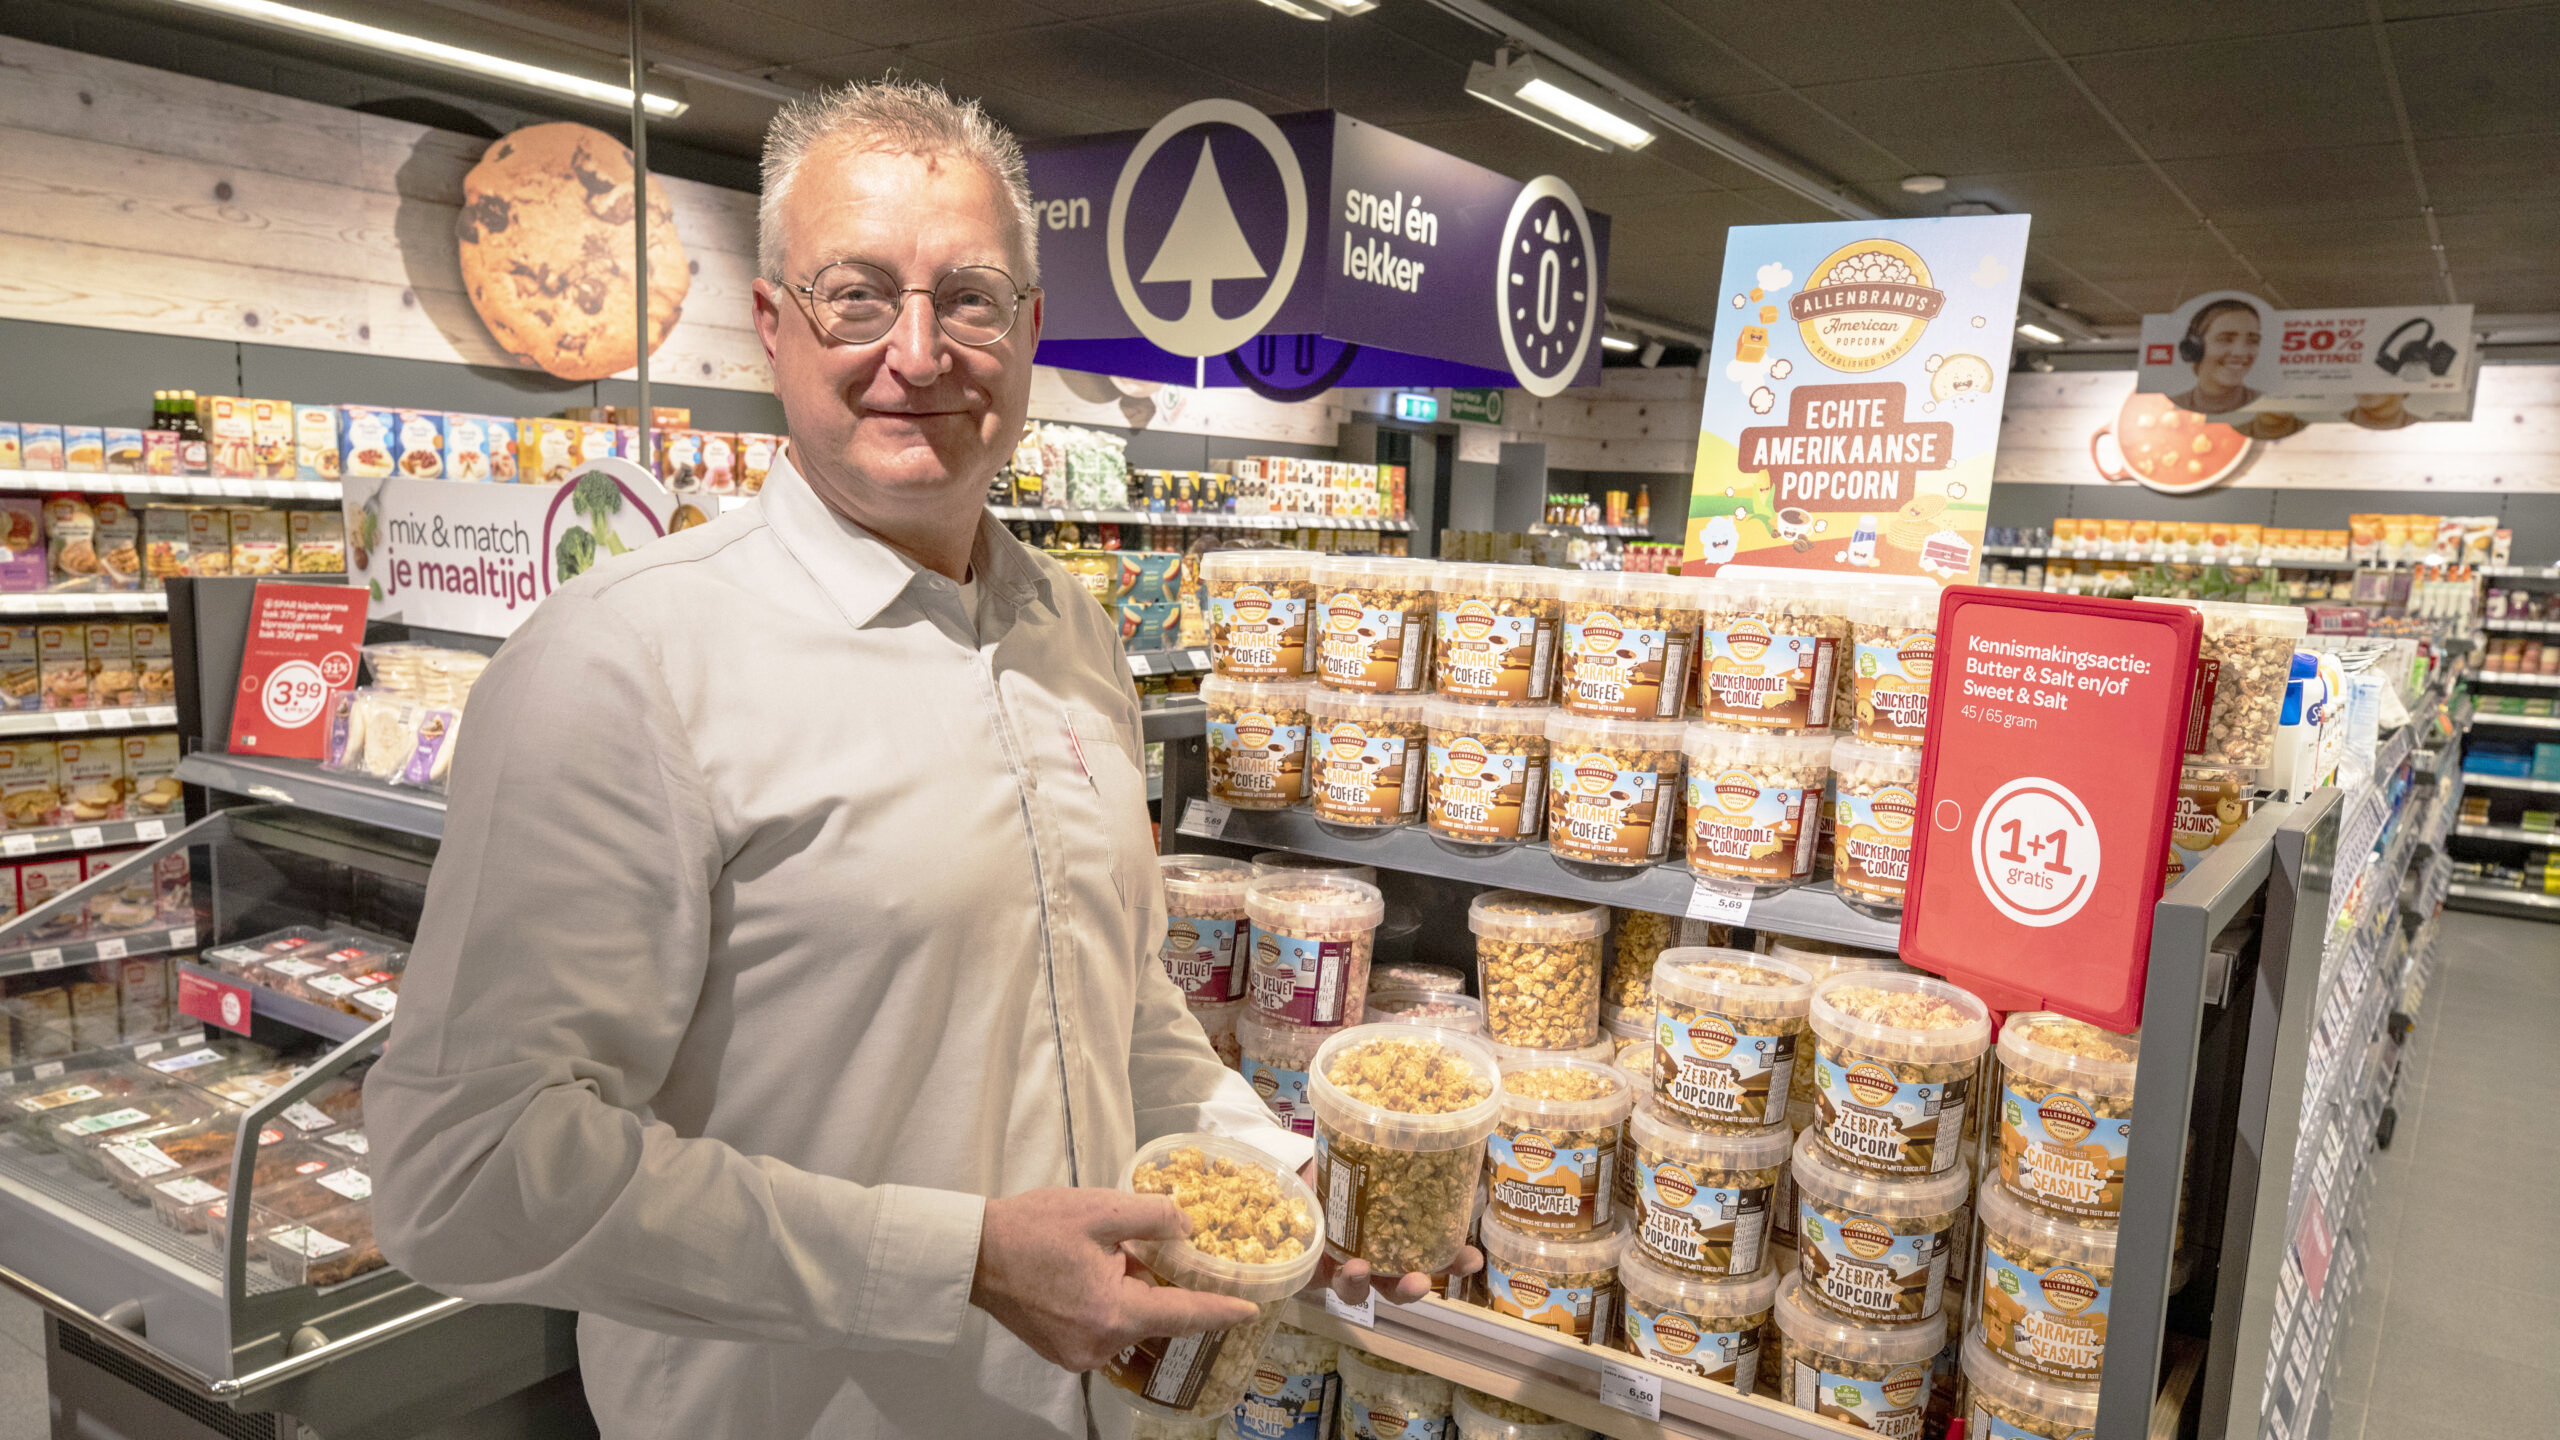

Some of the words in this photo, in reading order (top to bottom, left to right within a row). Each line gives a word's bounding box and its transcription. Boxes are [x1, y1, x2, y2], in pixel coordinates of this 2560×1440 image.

[1032, 197, 1090, 230] ren
[1345, 188, 1401, 236] snel
[1405, 195, 1438, 246] én
[1344, 231, 1424, 293] lekker
[1803, 290, 1929, 313] ALLENBRAND'S
[1823, 318, 1899, 335] American
[1836, 337, 1886, 346] POPCORN
[2282, 329, 2363, 352] 50%
[1817, 346, 1876, 368] ESTABLISHED
[2280, 353, 2362, 365] KORTING!
[1806, 398, 1886, 430] ECHTE
[1753, 433, 1938, 465] AMERIKAANSE
[1782, 470, 1899, 500] POPCORN
[389, 513, 428, 546] mix
[432, 516, 450, 548] &
[455, 520, 530, 555] match
[387, 548, 411, 595] je
[418, 557, 536, 609] maaltijd
[1231, 633, 1278, 648] CARAMEL
[1325, 640, 1367, 660] CARAMEL
[1236, 648, 1271, 664] COFFEE
[1452, 650, 1499, 669] CARAMEL
[1969, 634, 2150, 675] Kennismakingsactie:
[1328, 659, 1360, 676] COFFEE
[1455, 667, 1492, 685] COFFEE
[1578, 663, 1626, 684] CARAMEL
[1966, 657, 2021, 681] Butter
[2023, 666, 2037, 682] &
[2040, 668, 2074, 689] Salt
[2078, 674, 2128, 696] en/of
[1581, 682, 1618, 701] COFFEE
[1712, 673, 1785, 692] SNICKERDOODLE
[273, 681, 322, 706] 3.99
[1726, 690, 1761, 706] COOKIE
[1876, 692, 1928, 710] SNICKERD
[1963, 679, 2013, 704] Sweet
[2017, 688, 2030, 704] &
[2033, 690, 2068, 711] Salt
[1896, 710, 1926, 725] COOK
[1961, 705, 1977, 720] 45
[1986, 708, 2002, 723] 65
[2004, 713, 2037, 730] gram
[1230, 757, 1277, 774] CARAMEL
[1235, 773, 1271, 789] COFFEE
[1326, 767, 1372, 787] CARAMEL
[1330, 786, 1364, 803] COFFEE
[1443, 785, 1491, 806] CARAMEL
[1204, 816, 1222, 826] 5,69
[1446, 803, 1482, 822] COFFEE
[1567, 802, 1620, 825] CARAMEL
[1571, 821, 1611, 842] COFFEE
[1698, 821, 1772, 843] SNICKERDOODLE
[2173, 815, 2214, 833] SNICKE
[1712, 839, 1750, 857] COOKIE
[1850, 840, 1910, 863] SNICKERDOO
[2000, 818, 2073, 877] 1+1
[1868, 859, 1907, 878] COOKIE
[2008, 865, 2054, 890] gratis
[1718, 899, 1742, 909] 5,69
[1177, 961, 1213, 977] VELVET
[1263, 976, 1295, 996] VELVET
[1256, 989, 1275, 1007] CAKE
[1682, 1064, 1727, 1090] ZEBRA
[1849, 1075, 1894, 1092] ALLENBRAND'S
[1675, 1082, 1735, 1110] POPCORN
[1841, 1110, 1889, 1138] ZEBRA
[2042, 1110, 2091, 1127] ALLENBRAND'S
[1834, 1127, 1898, 1159] POPCORN
[2027, 1148, 2092, 1181] CARAMEL
[2069, 1150, 2088, 1159] FINEST
[2033, 1172, 2096, 1201] SEASALT
[1497, 1183, 1576, 1212] STROOPWAFEL
[1650, 1209, 1689, 1238] ZEBRA
[1645, 1226, 1697, 1258] POPCORN
[1844, 1230, 1890, 1245] ALLENBRAND'S
[1835, 1262, 1884, 1289] ZEBRA
[1827, 1278, 1893, 1309] POPCORN
[2045, 1282, 2093, 1297] ALLENBRAND'S
[2026, 1318, 2091, 1347] CARAMEL
[2031, 1338, 2094, 1366] SEASALT
[1629, 1387, 1653, 1402] 6,50
[1258, 1420, 1285, 1437] SALT
